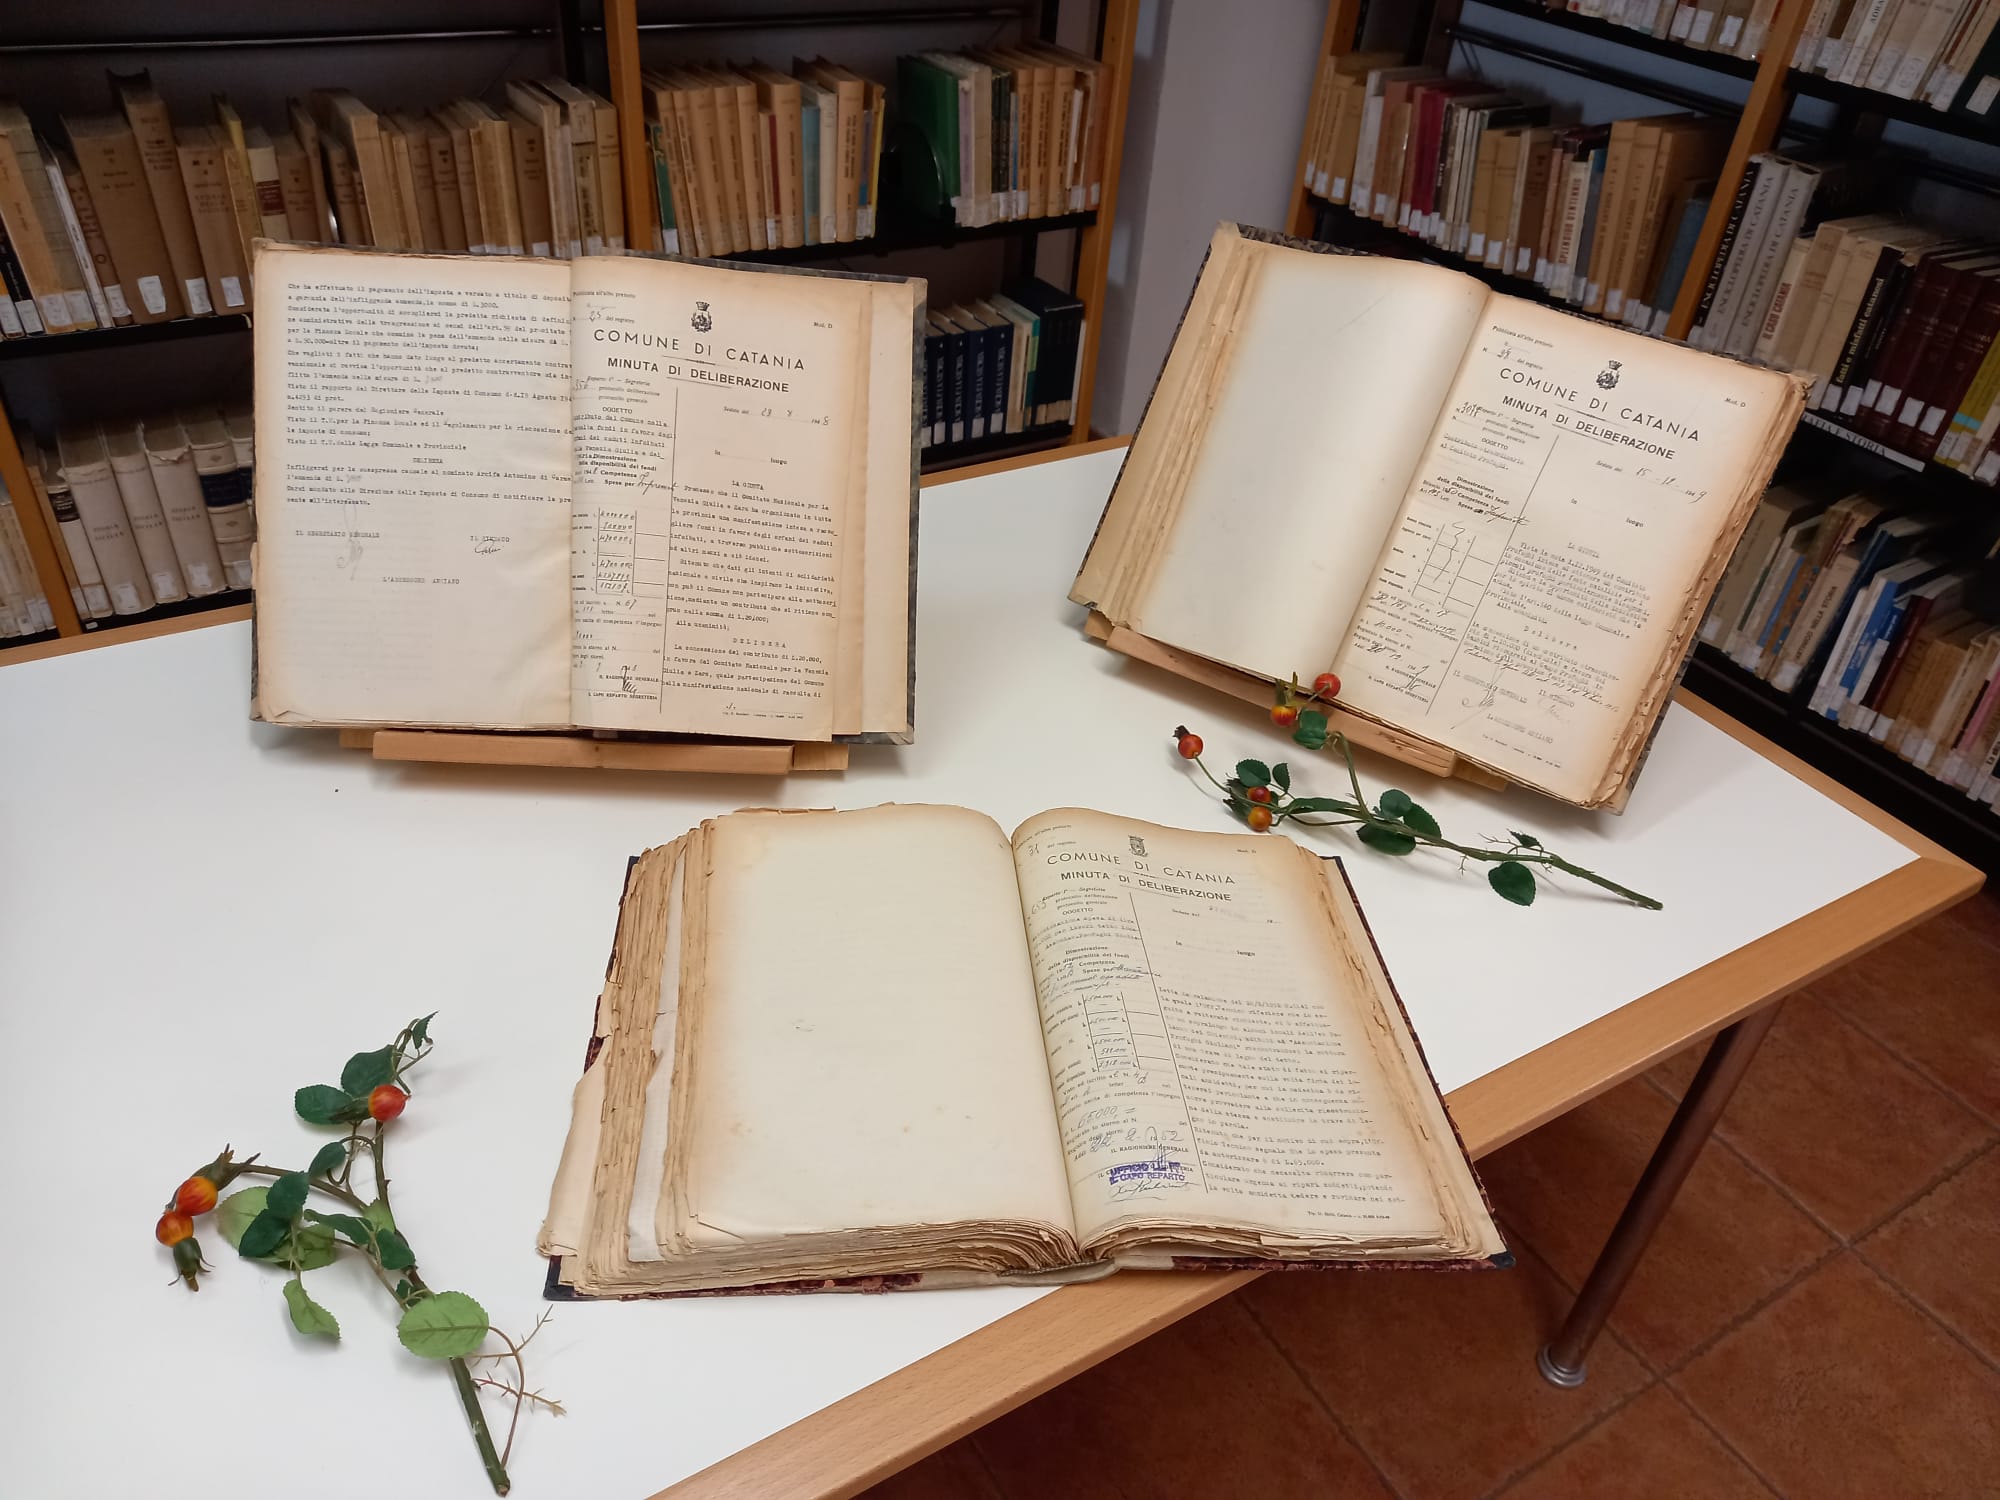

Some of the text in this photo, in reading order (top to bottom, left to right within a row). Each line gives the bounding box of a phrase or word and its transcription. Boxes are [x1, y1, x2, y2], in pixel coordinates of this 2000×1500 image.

[1718, 243, 1750, 314] ENCICLOPEDIA
[1750, 176, 1774, 227] CATANIA
[1741, 254, 1775, 327] ENCICLOPEDIA
[1776, 188, 1799, 239] CATANIA
[1773, 282, 1792, 312] CATANIA
[1836, 364, 1849, 384] fatti
[1863, 277, 1884, 318] catanesi
[593, 329, 805, 371] COMUNE DI CATANIA
[607, 357, 789, 393] MINUTA DI DELIBERAZIONE
[602, 406, 633, 414] OGGETTO
[1500, 367, 1700, 442] COMUNE DI CATANIA
[1502, 395, 1676, 461] MINUTA DI DELIBERAZIONE
[1481, 437, 1509, 450] OGGETTO
[1845, 430, 1886, 457] STORIA
[1456, 476, 1494, 493] Dimostrazione
[1457, 492, 1489, 507] Competenza
[1822, 585, 1838, 609] STORIA
[1047, 852, 1236, 885] COMUNE DI CATANIA
[1060, 871, 1232, 902] MINUTA DI DELIBERAZIONE
[1062, 907, 1094, 916] OGGETTO
[1065, 946, 1108, 955] Dimostrazione
[1119, 1144, 1156, 1152] RAGIONIERE
[1157, 1144, 1189, 1153] GENERALE
[1110, 1163, 1150, 1177] UFFICIO
[1120, 1172, 1185, 1182] CAPO REPARTO
